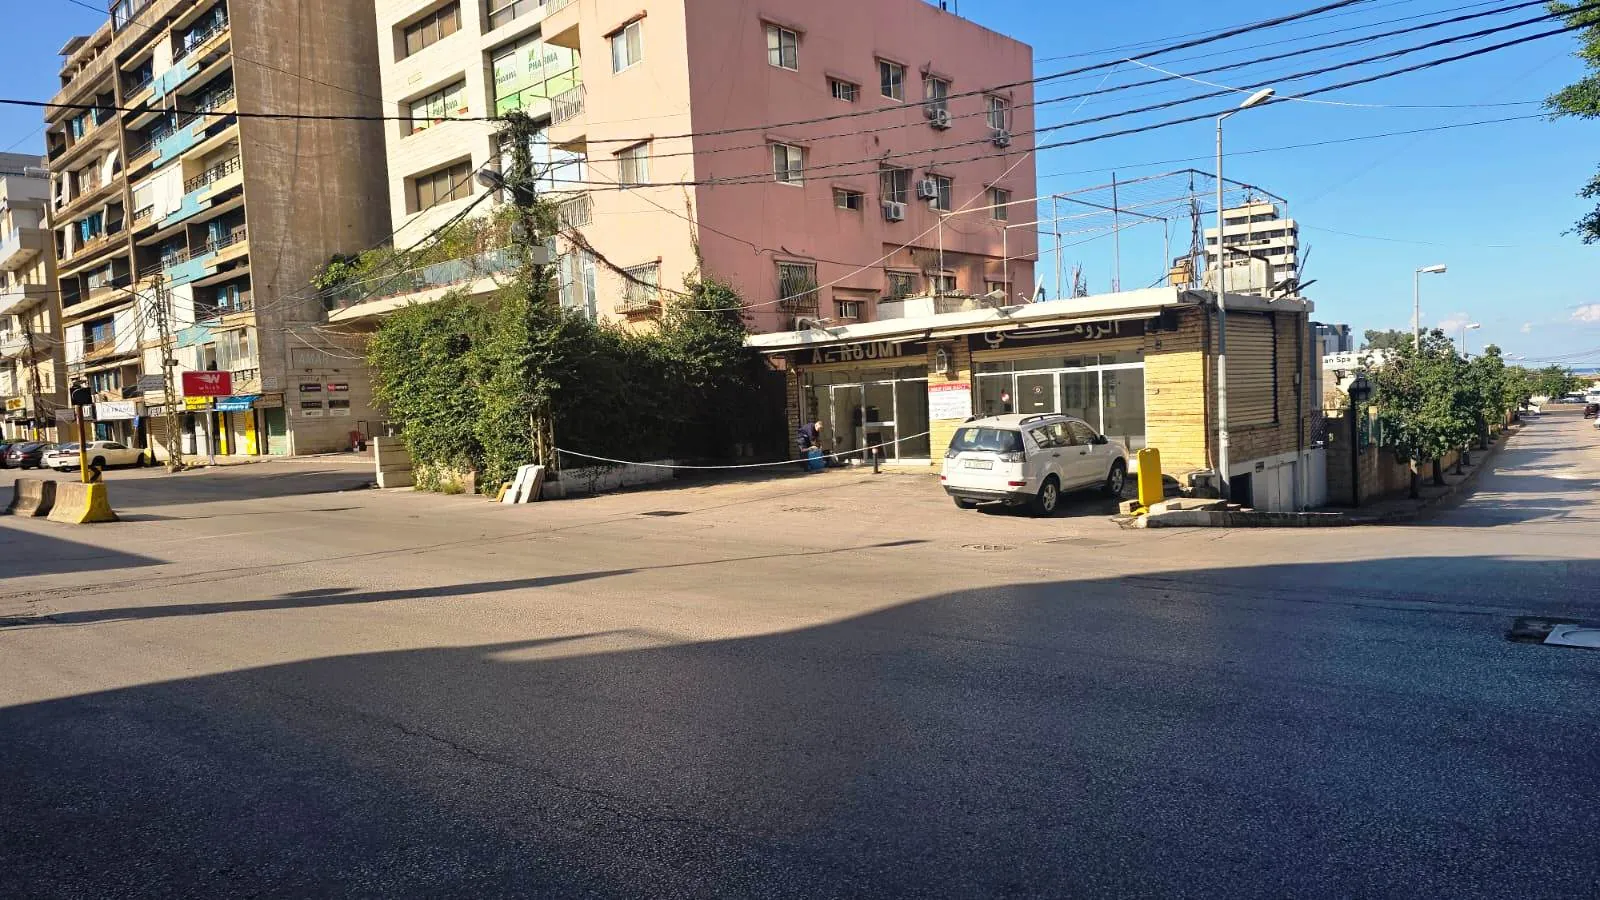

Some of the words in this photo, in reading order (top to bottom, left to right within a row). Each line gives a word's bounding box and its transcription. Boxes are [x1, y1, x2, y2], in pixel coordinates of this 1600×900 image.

[528, 52, 558, 72] PHARMA
[984, 320, 1120, 349] الرومي
[812, 346, 836, 364] AL
[841, 341, 903, 361] ROUMI
